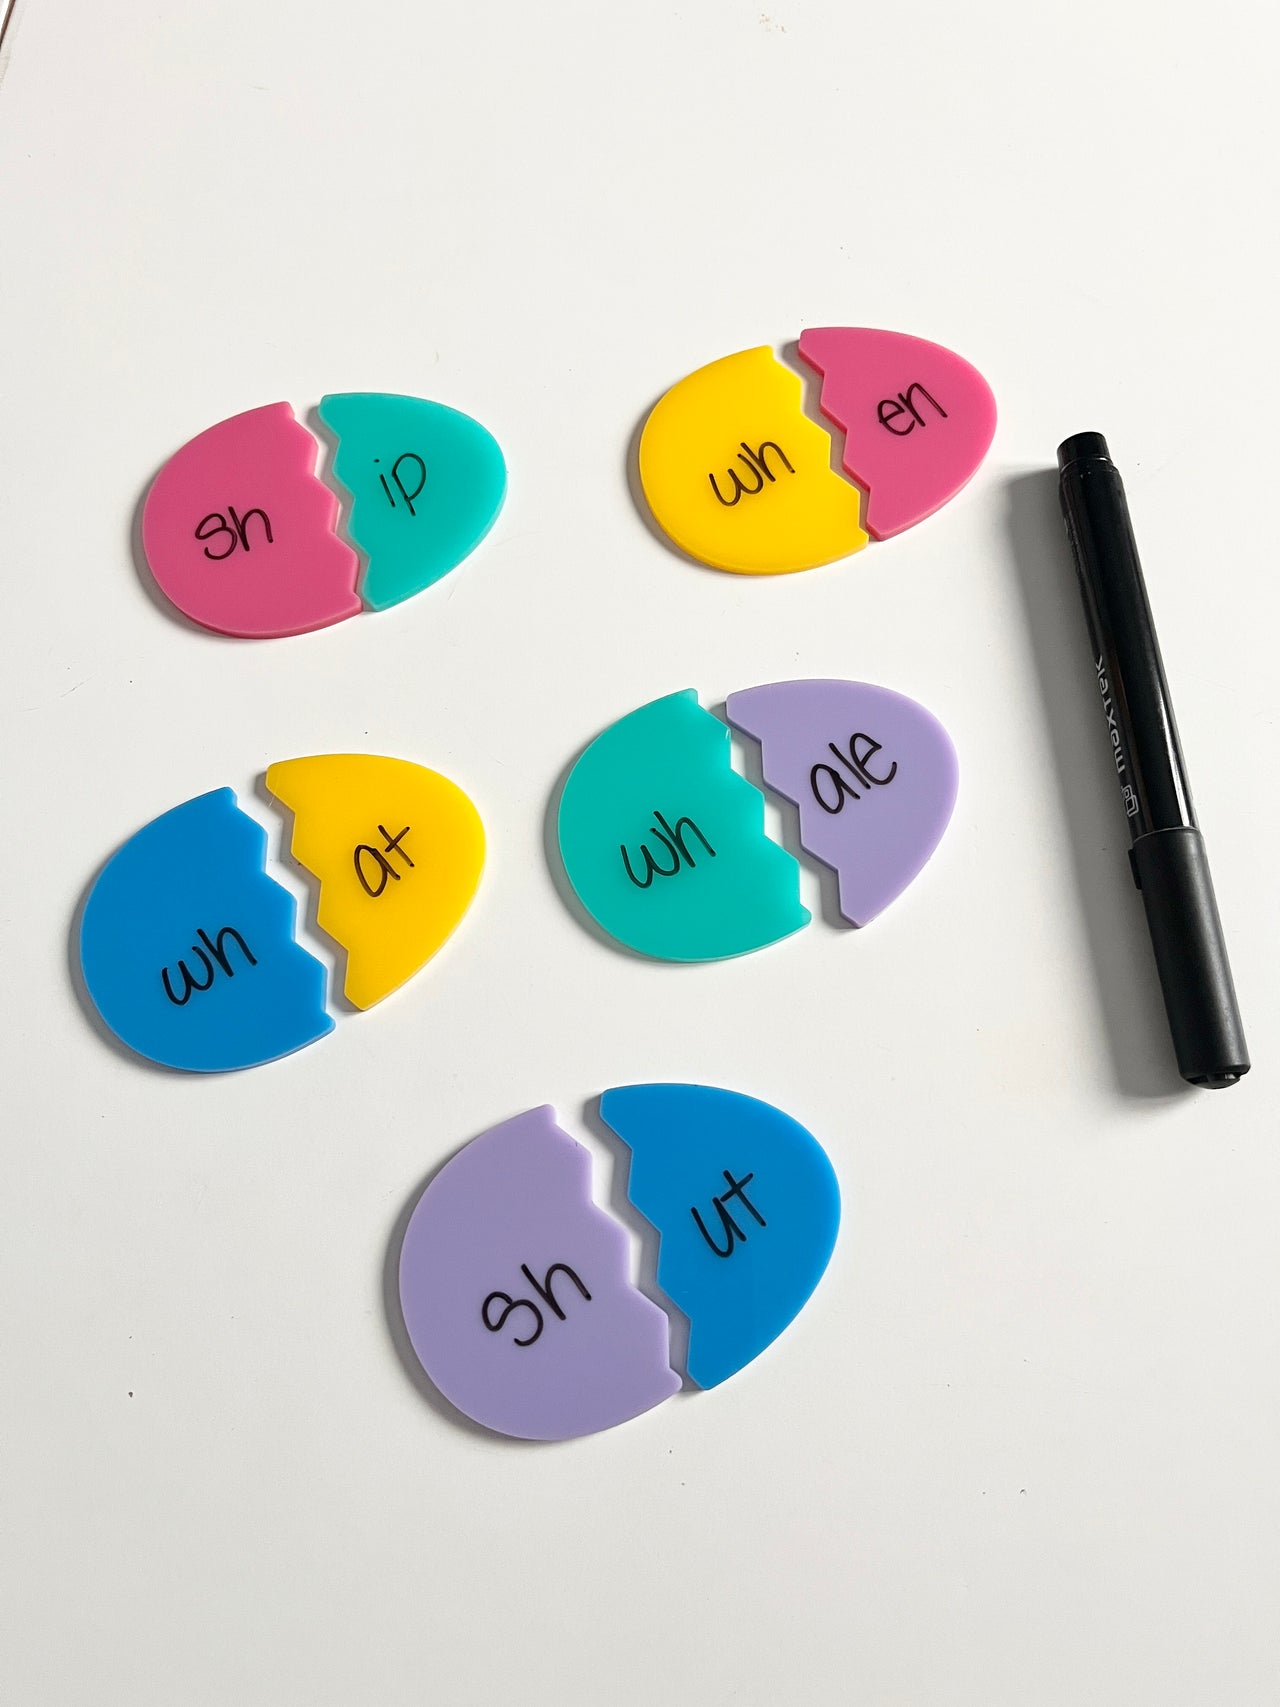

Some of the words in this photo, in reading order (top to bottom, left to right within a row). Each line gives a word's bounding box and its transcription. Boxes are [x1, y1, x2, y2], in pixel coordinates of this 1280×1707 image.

[195, 506, 274, 561] sh
[374, 452, 427, 517] ip
[710, 441, 796, 506] wh
[878, 382, 948, 436] en
[621, 811, 717, 889] wh
[809, 732, 898, 815] ale
[161, 926, 258, 1006] wh
[353, 824, 415, 898] at
[481, 1262, 592, 1348] sh
[690, 1169, 767, 1259] ut
